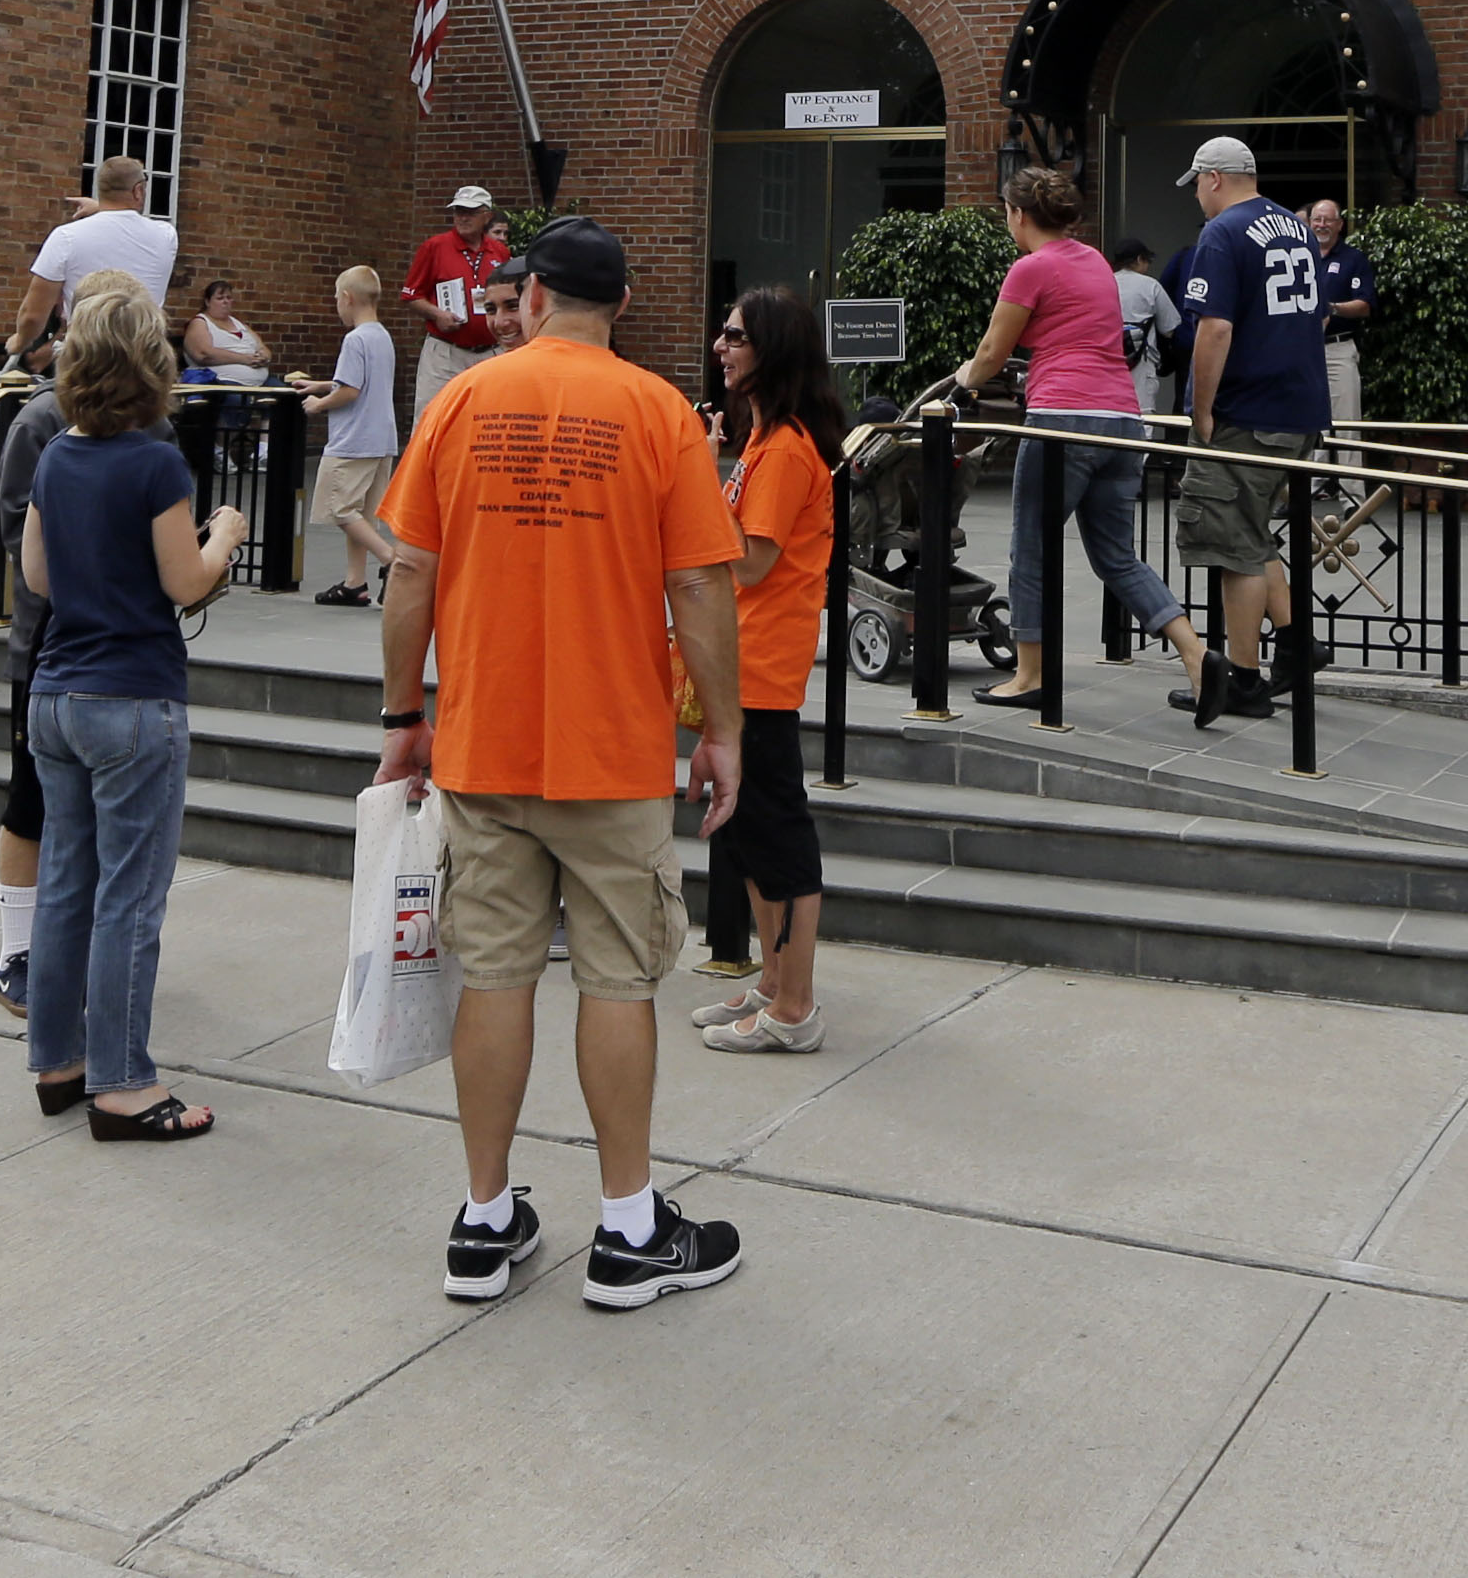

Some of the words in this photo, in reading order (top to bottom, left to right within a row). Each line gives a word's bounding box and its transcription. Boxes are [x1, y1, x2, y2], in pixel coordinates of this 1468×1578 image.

[791, 95, 811, 105] VIP
[815, 94, 873, 104] ENTRANCE
[804, 113, 858, 123] RE-ENTRY
[1245, 214, 1309, 248] MATTINGLY
[1265, 247, 1319, 316] 23
[473, 414, 500, 422] DAVID
[509, 424, 539, 432] CROSS
[557, 425, 582, 434] KEITH
[477, 434, 502, 442] TYLER
[552, 435, 580, 444] JASON
[551, 445, 587, 457] MICHAEL
[590, 451, 618, 462] LEAHY
[512, 477, 543, 485] DANNY
